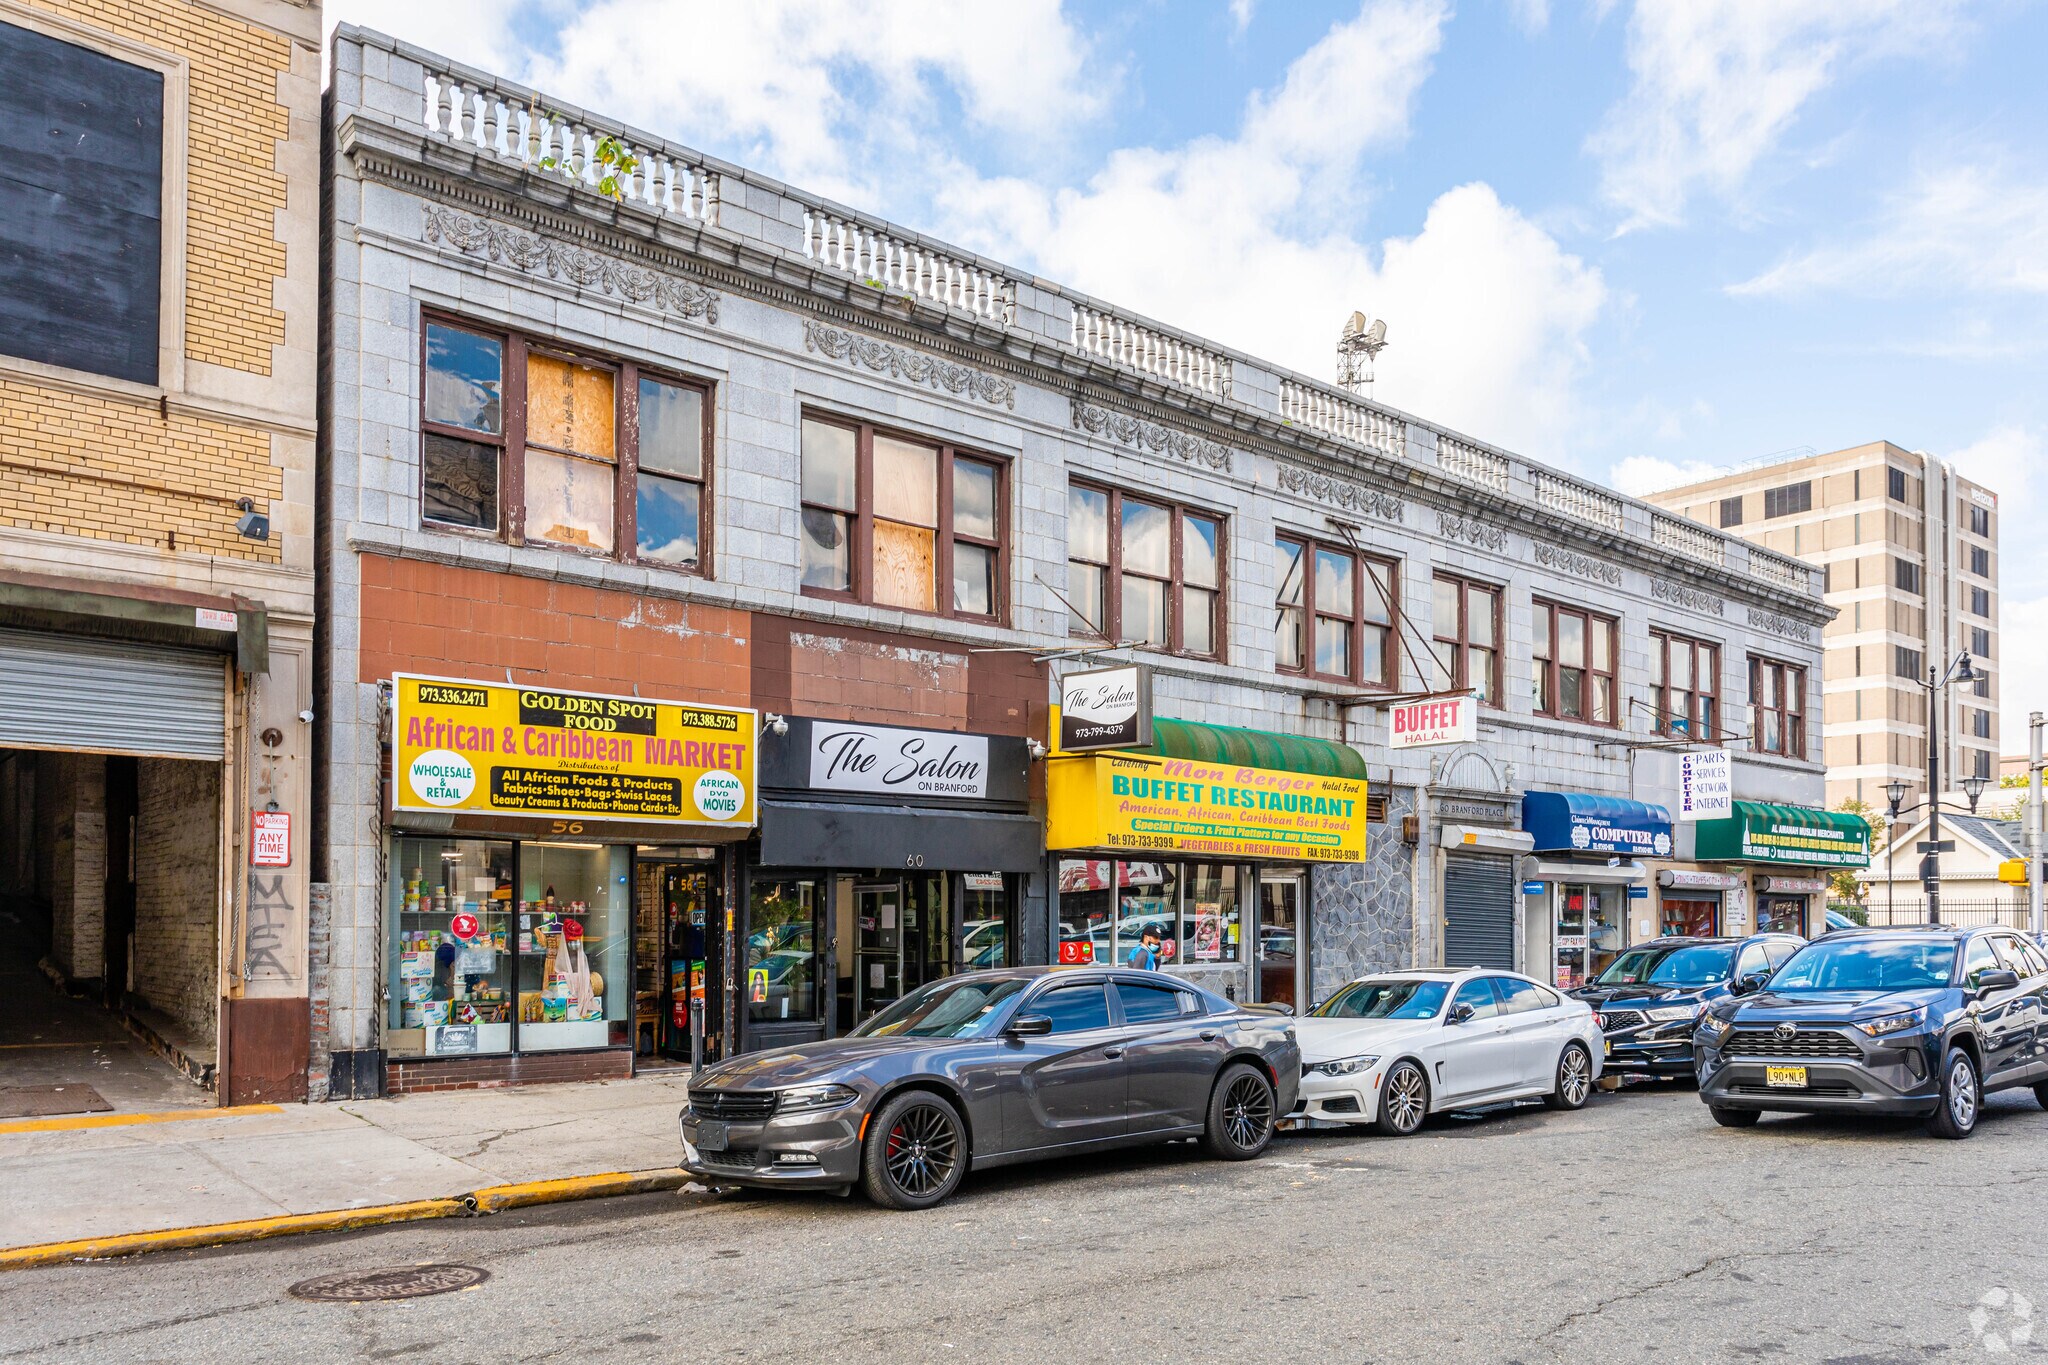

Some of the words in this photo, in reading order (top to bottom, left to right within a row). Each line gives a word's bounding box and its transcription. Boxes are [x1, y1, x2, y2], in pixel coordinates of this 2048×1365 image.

[420, 686, 485, 706] 973.336.2471
[1065, 688, 1089, 712] The
[1091, 685, 1135, 710] Salon
[521, 691, 604, 716] GOLDEN
[608, 700, 655, 720] SPOT
[564, 714, 617, 732] FOOD
[683, 712, 736, 729] 973.388.5726
[1394, 701, 1460, 734] BUFFET
[1075, 724, 1124, 738] 973-799-4379
[1405, 731, 1449, 743] HALAL
[406, 716, 494, 752] African
[502, 727, 518, 754] &
[523, 727, 632, 763] Caribbean
[645, 737, 746, 770] MARKET
[818, 731, 879, 780] The
[882, 738, 982, 785] Salon
[1696, 753, 1726, 764] PARTS
[413, 764, 472, 779] WHOLESALE
[611, 764, 620, 773] of
[1163, 759, 1224, 781] Mon
[1234, 768, 1315, 791] Berger
[1696, 767, 1726, 779] SERVICES
[439, 778, 446, 787] &
[502, 770, 520, 781] All
[523, 771, 569, 785] African
[573, 775, 608, 787] Foods
[611, 777, 621, 788] &
[624, 778, 673, 791] Products
[700, 779, 739, 789] AFRICAN
[918, 781, 932, 791] ON
[934, 783, 978, 794] BRANFORD
[1322, 781, 1340, 792] Halal
[1341, 783, 1360, 794] Food
[1682, 755, 1693, 811] COMPUTER
[1696, 782, 1729, 793] NETWORK
[426, 787, 461, 799] RETAIL
[615, 789, 643, 801] Swiss
[645, 791, 672, 802] Laces
[1112, 774, 1205, 803] BUFFET
[1211, 785, 1355, 818] RESTAURANT
[493, 794, 525, 808] Beauty
[528, 796, 561, 808] Creams
[562, 797, 570, 807] &
[572, 798, 609, 810] Products
[613, 801, 639, 812] Phone
[640, 802, 664, 813] Cards
[703, 798, 736, 812] MOVIES
[1696, 797, 1729, 810] INTERNET
[1119, 800, 1182, 818] American,
[1187, 806, 1235, 822] African,
[1239, 810, 1292, 826] Caribbean
[1296, 816, 1318, 828] Best
[1322, 818, 1351, 831] Foods
[1451, 805, 1484, 815] BRANFORD
[1484, 808, 1504, 817] PLACE
[255, 815, 264, 825] NO
[265, 817, 288, 826] PARKING
[551, 821, 584, 834] 56
[258, 833, 283, 843] ANY
[1135, 819, 1172, 831] Special
[1173, 822, 1205, 834] Orders
[1206, 826, 1213, 835] &
[1214, 825, 1235, 836] Fruit
[1236, 827, 1271, 839] Platters
[1271, 830, 1284, 840] for
[1285, 832, 1301, 842] any
[1301, 833, 1339, 845] Occasion
[1591, 826, 1652, 845] COMPUTER
[1107, 833, 1121, 845] Tel:
[1122, 834, 1174, 848] 973-733-9399
[257, 843, 284, 853] TIME
[1181, 839, 1234, 853] VEGETABLES
[1236, 844, 1242, 853] &
[1244, 842, 1271, 855] FRESH
[1272, 845, 1301, 857] FRUITS
[1307, 847, 1320, 858] FAX:
[906, 854, 924, 868] 60
[681, 879, 693, 891] 56
